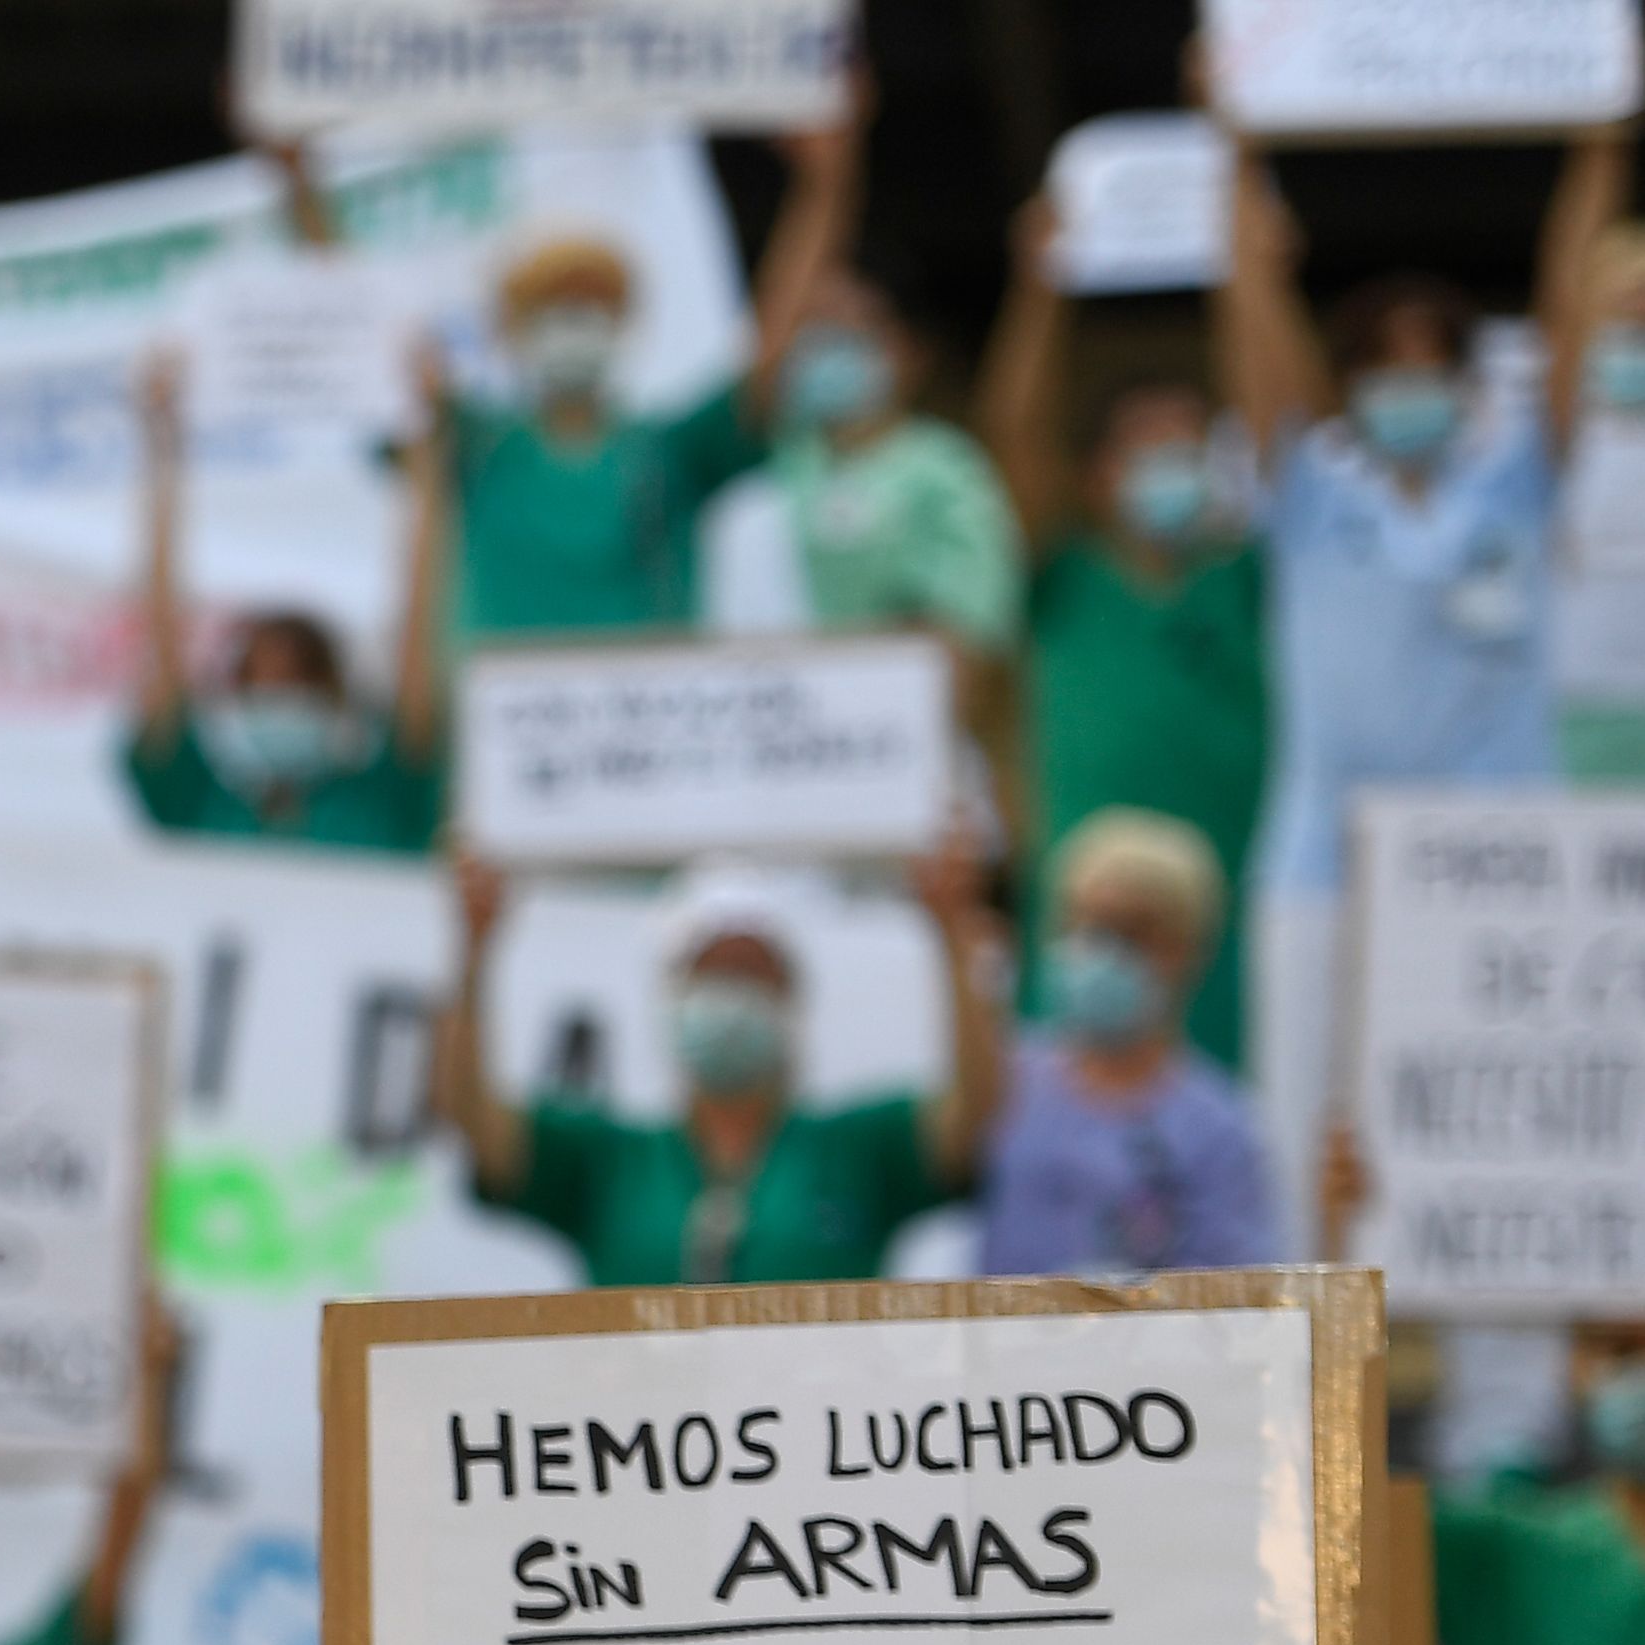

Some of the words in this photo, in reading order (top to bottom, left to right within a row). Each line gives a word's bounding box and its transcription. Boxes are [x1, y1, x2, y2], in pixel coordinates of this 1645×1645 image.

[449, 1407, 781, 1505] HEMOS
[827, 1389, 1197, 1480] LUCHADO
[714, 1506, 1100, 1603] ARMAS
